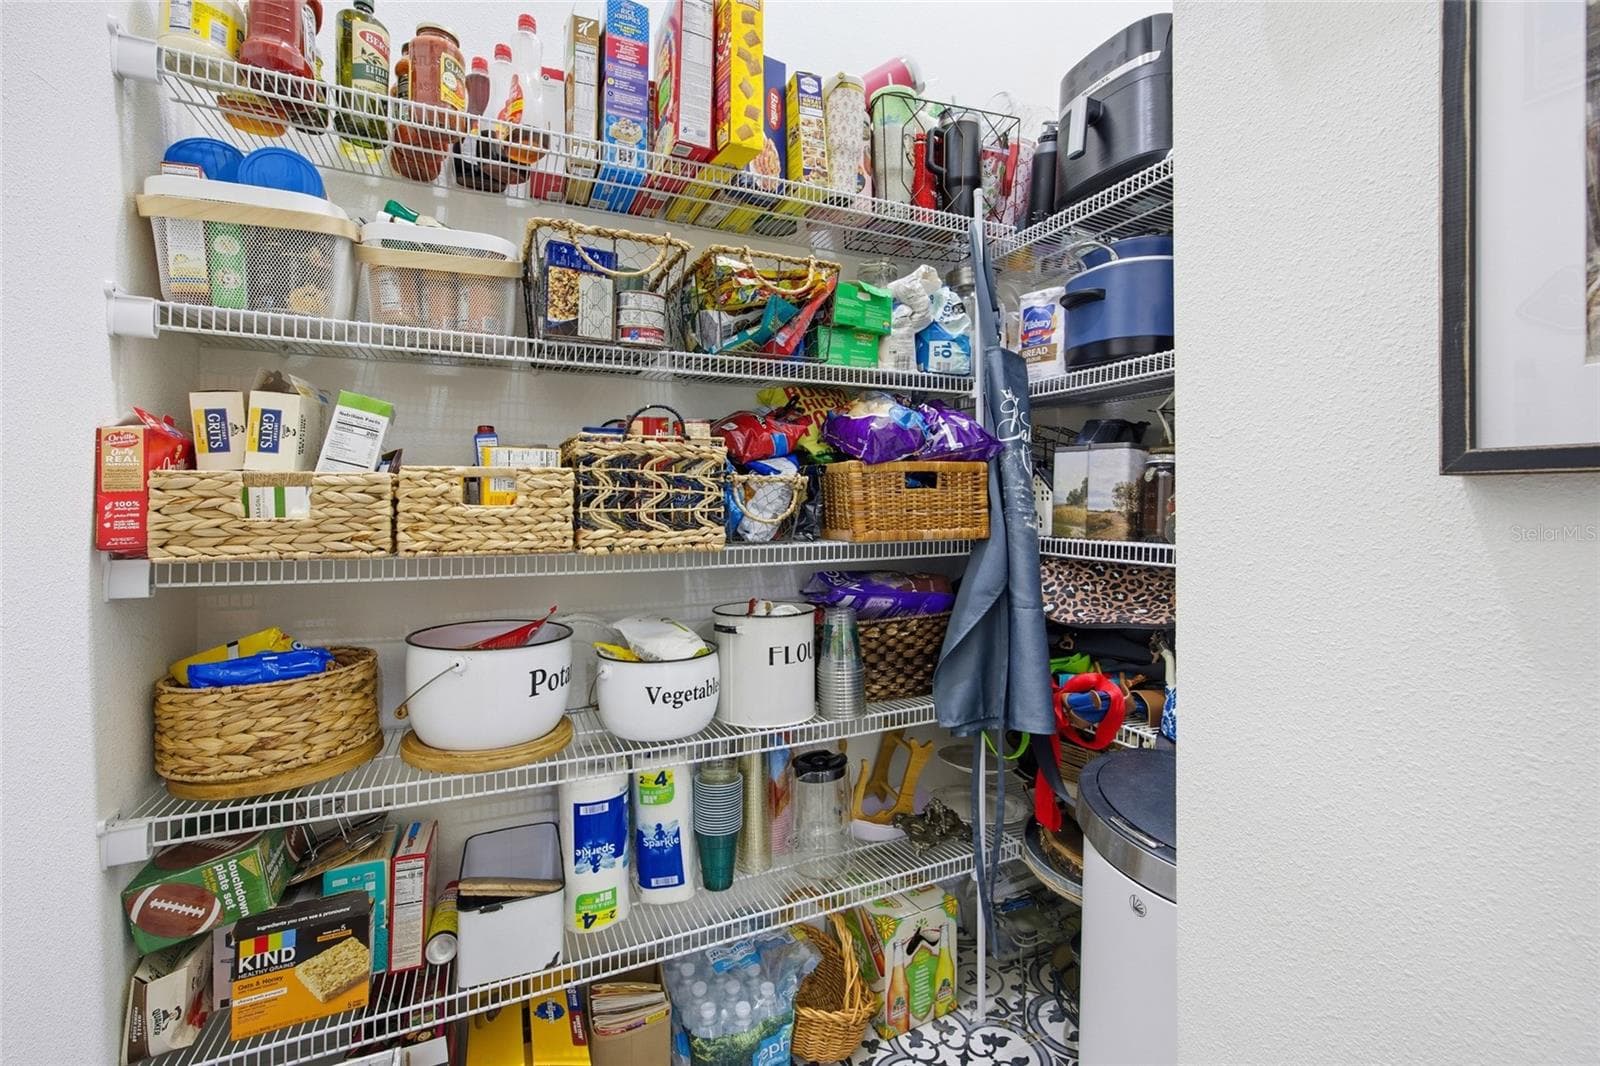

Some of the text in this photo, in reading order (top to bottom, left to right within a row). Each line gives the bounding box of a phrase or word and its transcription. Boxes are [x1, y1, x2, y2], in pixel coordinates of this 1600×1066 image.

[770, 92, 779, 127] Barilla
[934, 345, 940, 357] LB
[941, 342, 952, 359] 10
[1022, 346, 1048, 358] BREAD
[108, 433, 135, 442] Orville
[207, 413, 224, 449] GRITS
[260, 413, 276, 449] GRITS
[105, 455, 139, 463] REAL
[645, 677, 720, 709] Vegetable
[655, 771, 668, 786] 4
[643, 832, 680, 849] Sparkle
[575, 842, 615, 859] Sparkle
[213, 864, 237, 911] plate set
[227, 859, 250, 918] touchdown
[582, 912, 597, 929] 4
[238, 946, 296, 974] KIND
[239, 961, 297, 980] HEALTHY GRAINS
[238, 982, 254, 991] Oats
[262, 975, 284, 985] Honey
[152, 1008, 162, 1036] QUAKER
